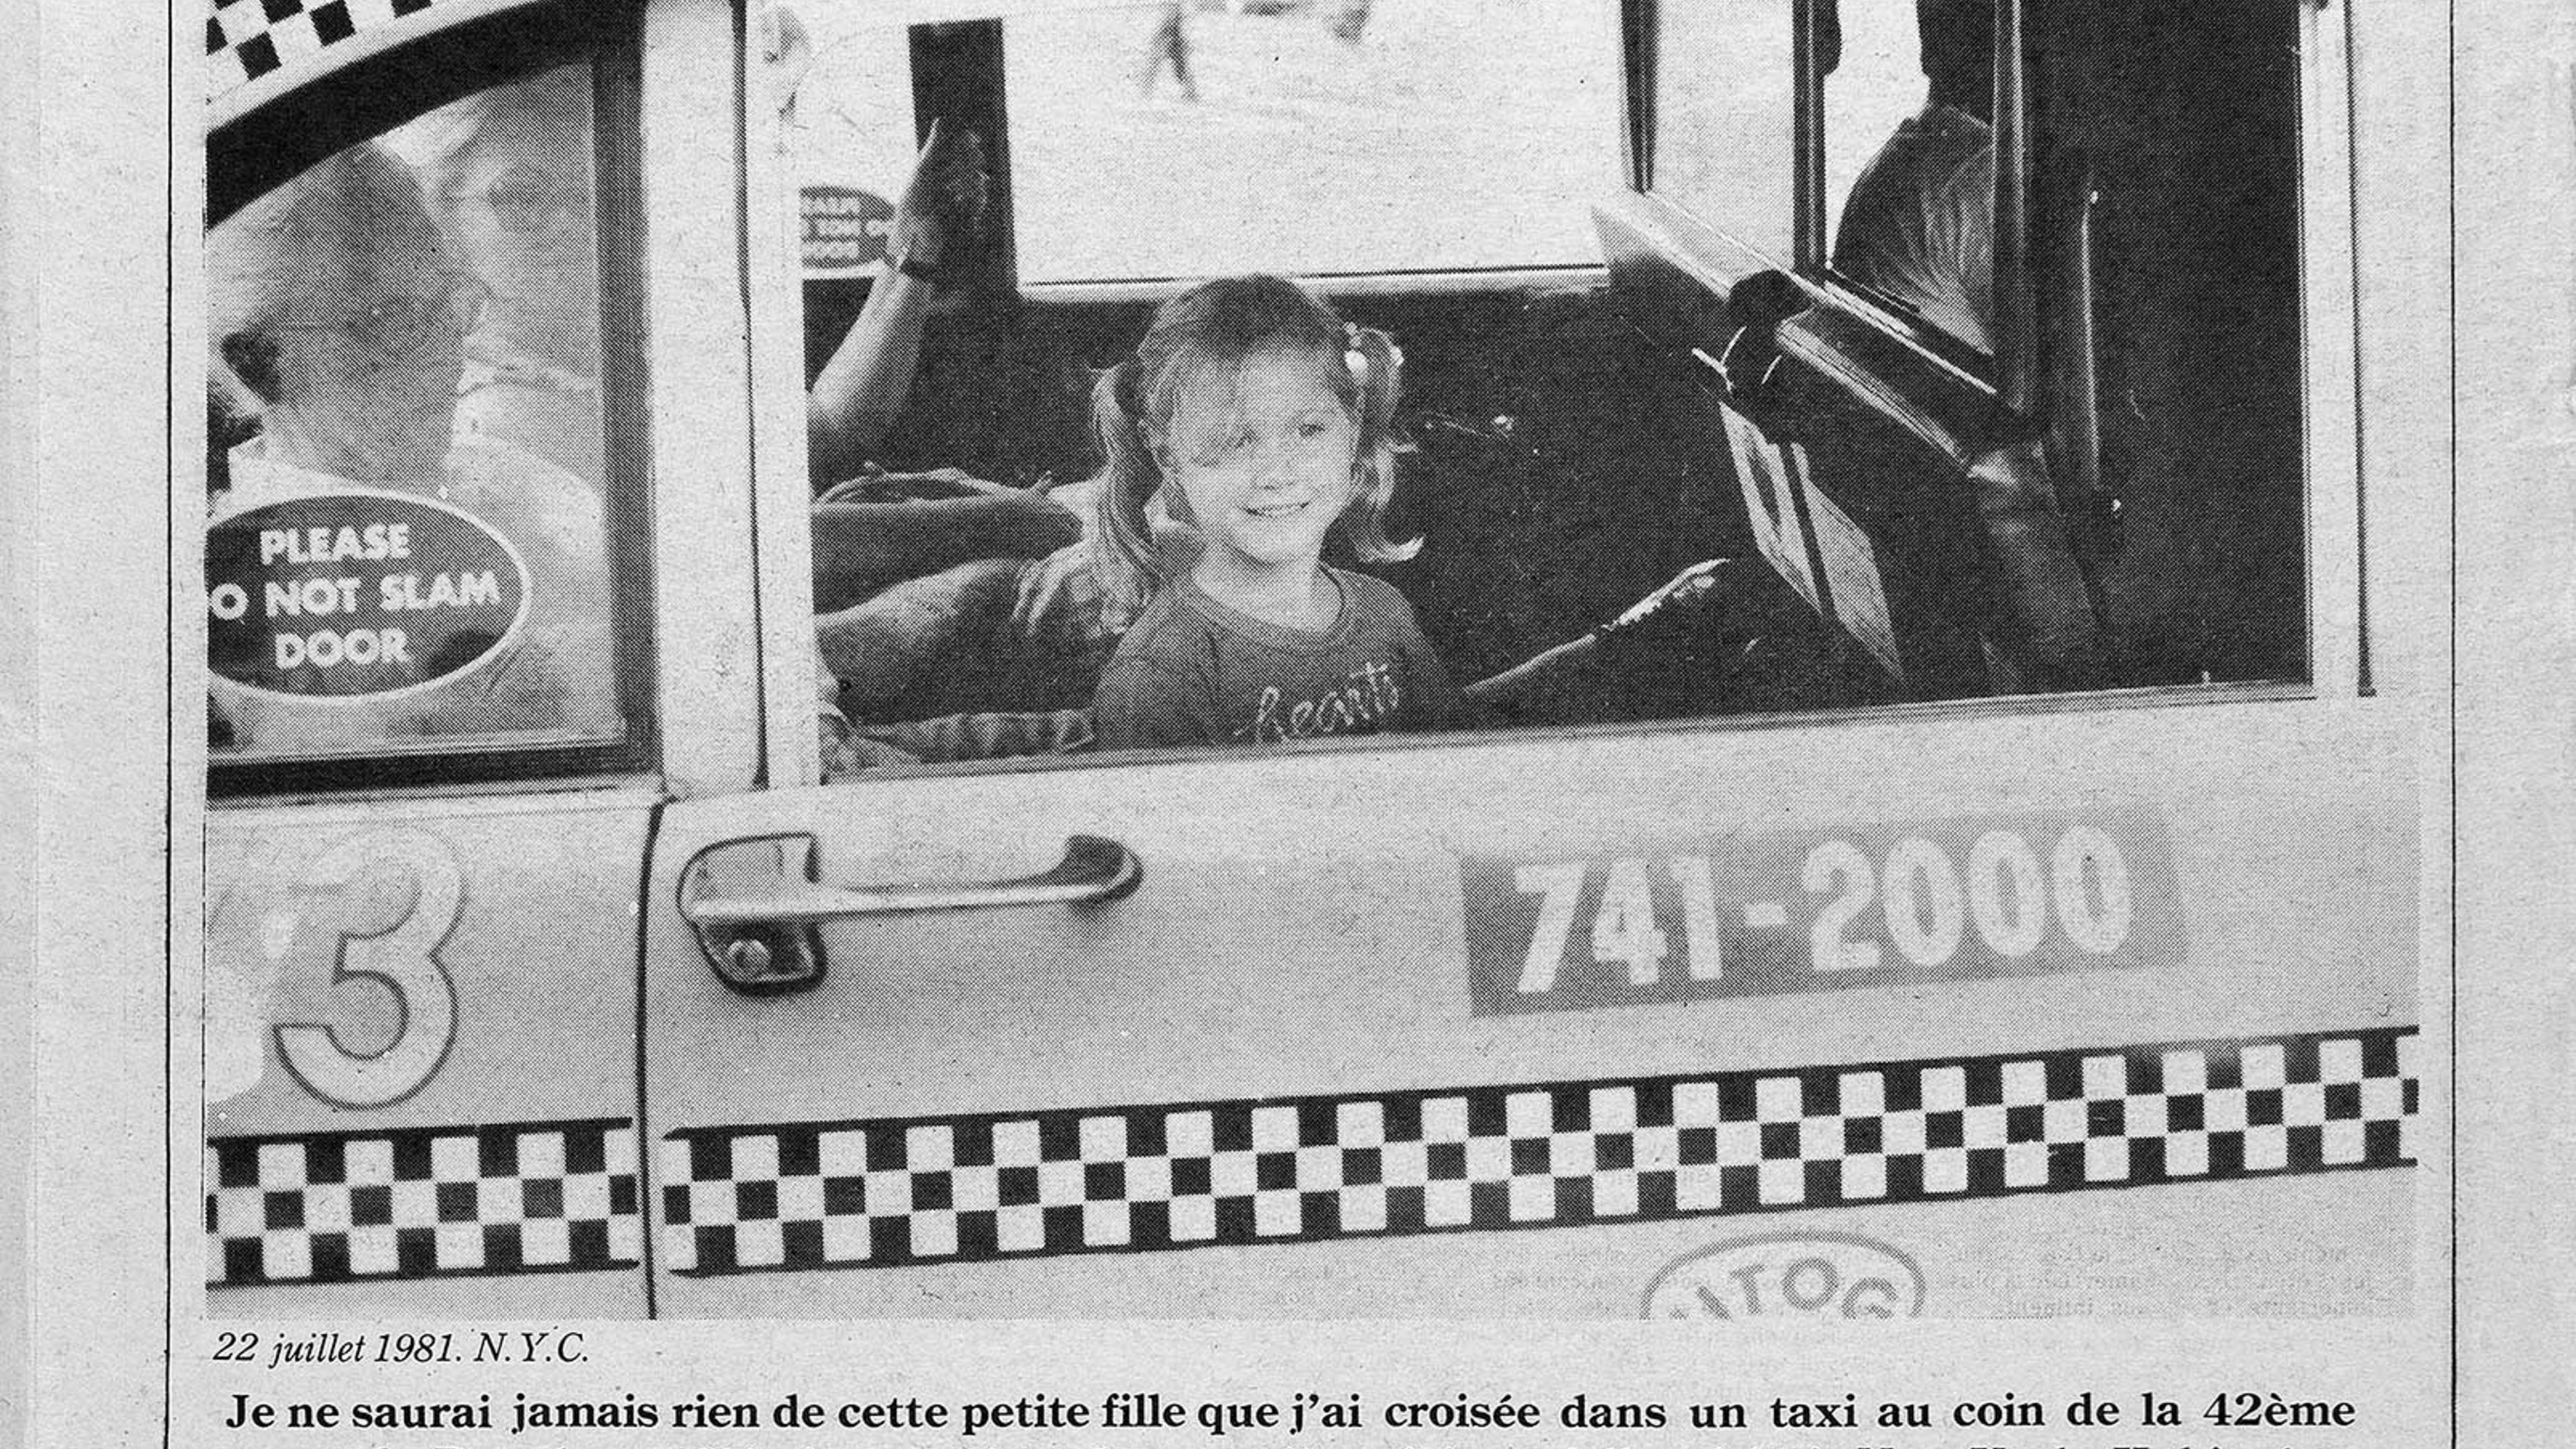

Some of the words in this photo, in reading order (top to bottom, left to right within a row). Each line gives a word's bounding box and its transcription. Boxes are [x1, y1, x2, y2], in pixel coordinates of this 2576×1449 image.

[260, 523, 411, 565] PLEASE
[209, 582, 250, 621] O
[266, 577, 362, 617] NOT
[380, 570, 500, 612] SLAM
[275, 628, 409, 669] DOOR
[1515, 823, 2134, 995] 741-2000
[213, 1332, 259, 1361] 22
[268, 1332, 365, 1369] juillet
[374, 1333, 463, 1362] 1981.
[227, 1395, 274, 1428] Je
[288, 1405, 338, 1427] ne
[353, 1395, 492, 1428] saurai
[512, 1393, 657, 1434] jamais
[673, 1394, 759, 1427] rien
[773, 1394, 824, 1428] de
[839, 1399, 947, 1427] cette
[963, 1394, 1089, 1435] petite
[1103, 1393, 1185, 1427] fille
[1199, 1404, 1278, 1435] que
[1290, 1393, 1362, 1434] j’ai
[1386, 1393, 1540, 1428] croisée
[1562, 1395, 1666, 1428] dans
[1690, 1405, 1746, 1428] un
[1771, 1394, 1857, 1427] taxi
[1878, 1404, 1931, 1427] au
[1954, 1393, 2045, 1426] coin
[2068, 1393, 2118, 1426] de
[2143, 1393, 2181, 1426] la
[2204, 1393, 2355, 1426] 42ème
